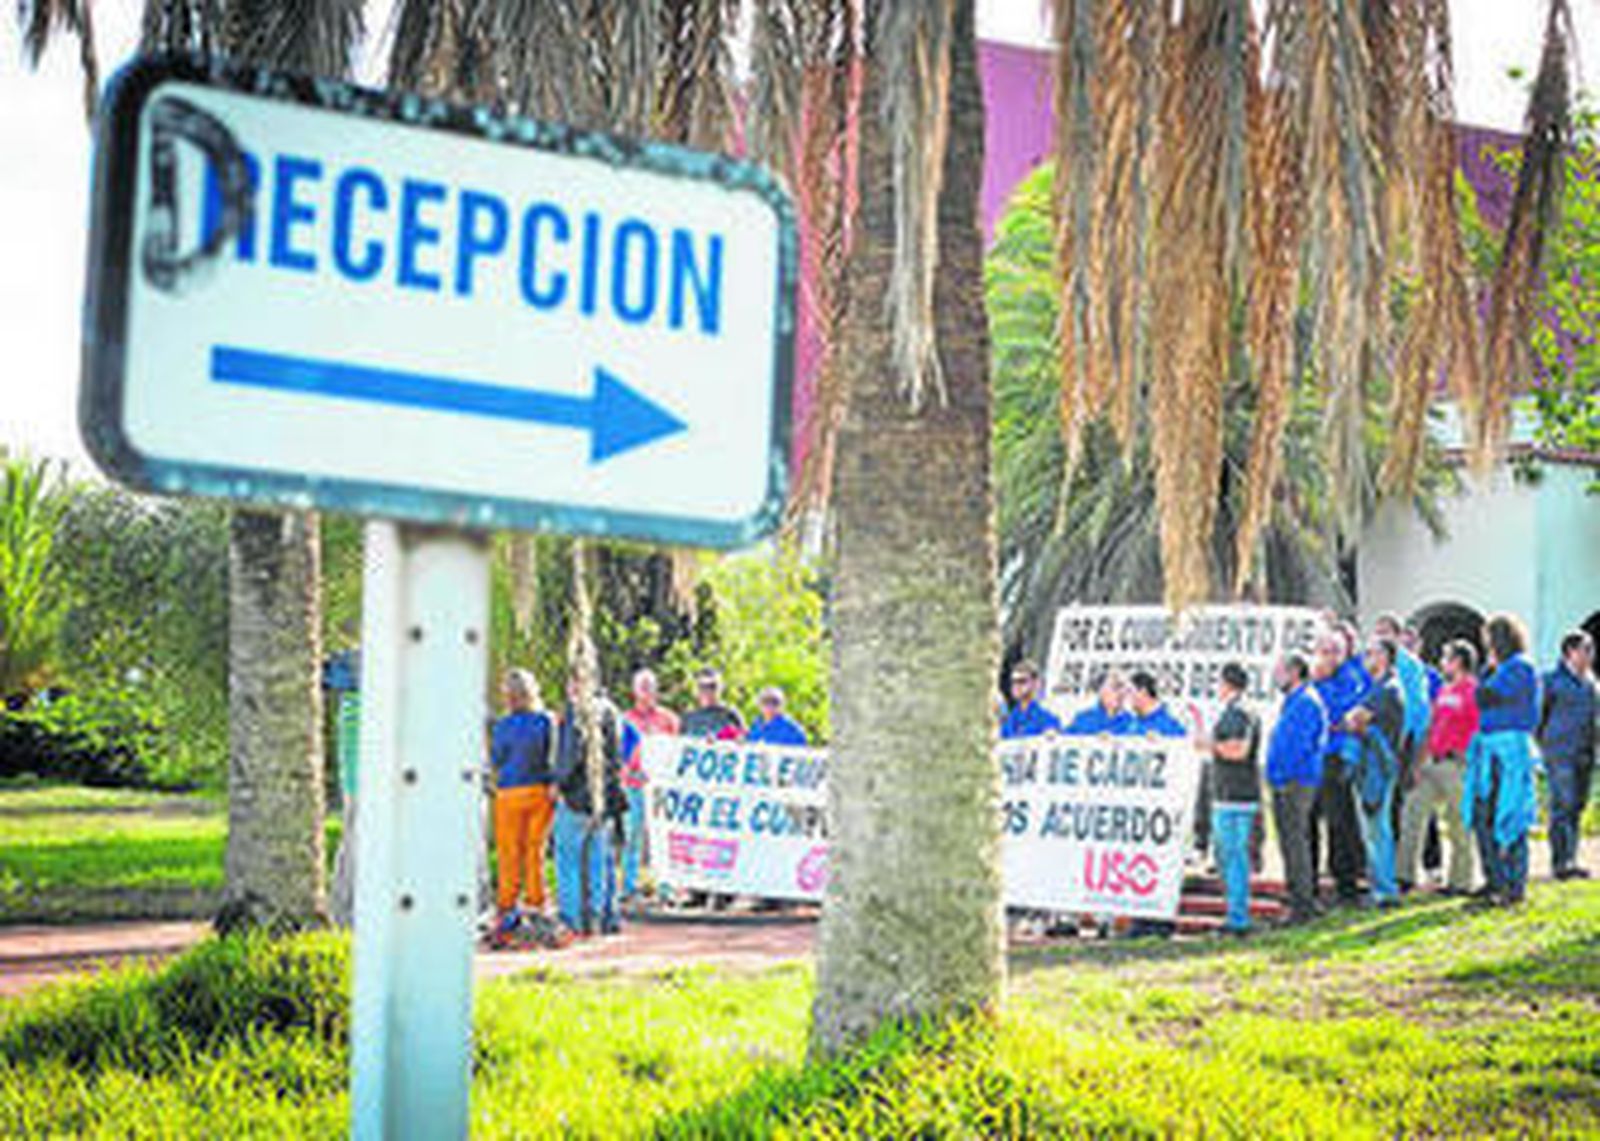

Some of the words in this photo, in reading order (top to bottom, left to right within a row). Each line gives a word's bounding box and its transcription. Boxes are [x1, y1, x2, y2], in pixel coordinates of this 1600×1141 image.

[200, 150, 724, 336] RECEPCION
[677, 746, 740, 784] POR
[742, 752, 772, 788] EL
[1047, 749, 1081, 786] DE
[708, 797, 741, 831] EL
[1083, 847, 1161, 896] USO
